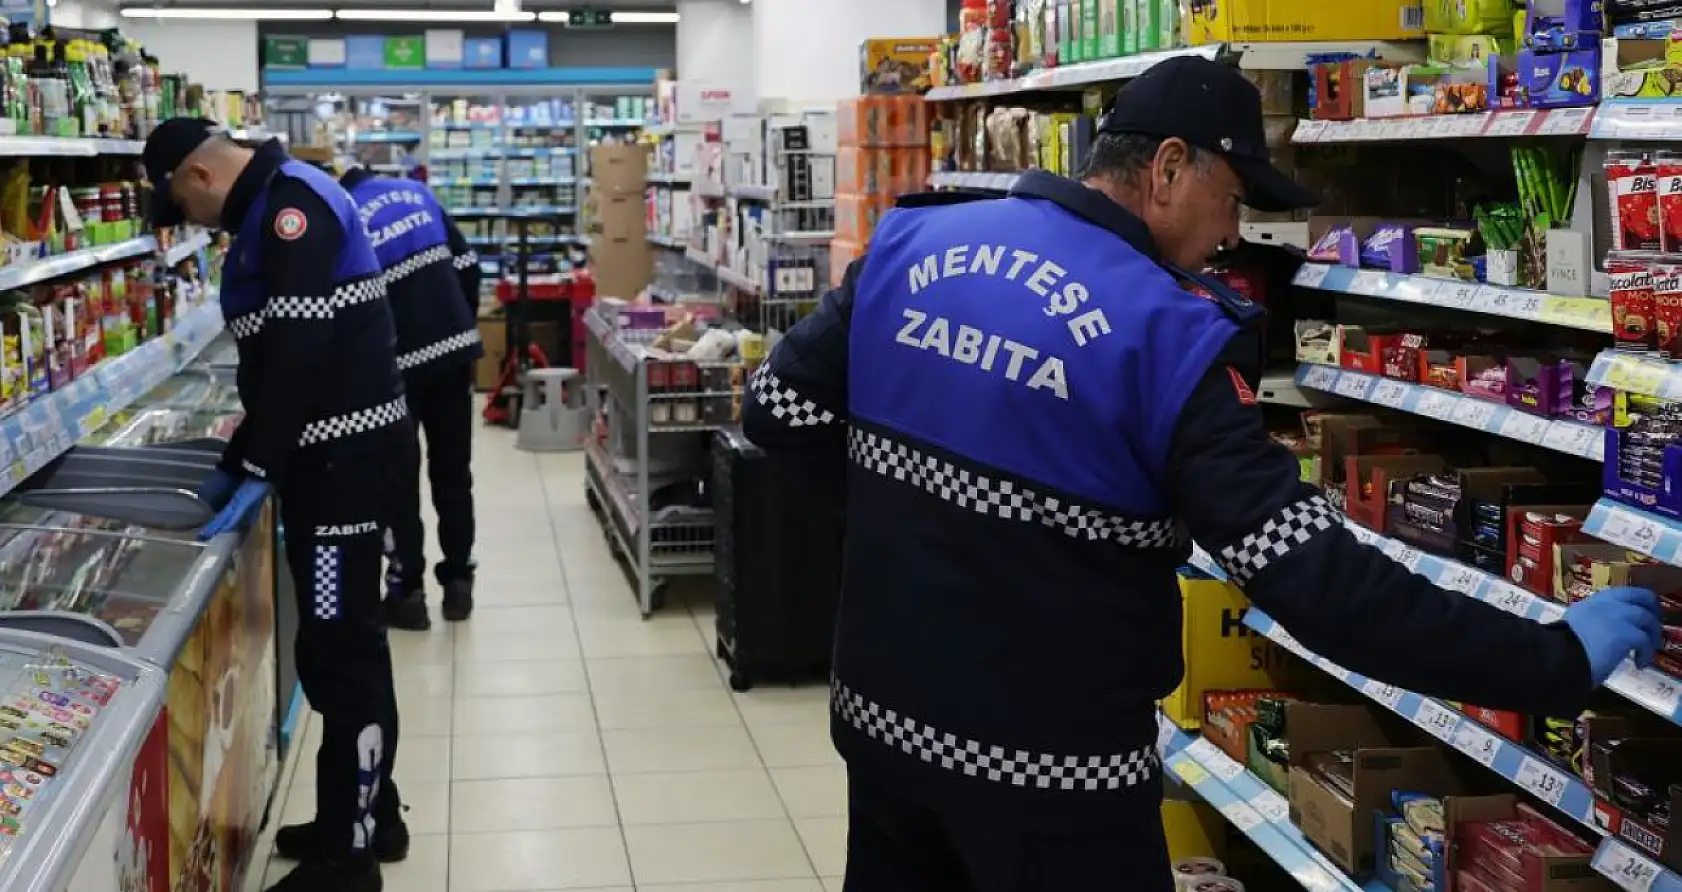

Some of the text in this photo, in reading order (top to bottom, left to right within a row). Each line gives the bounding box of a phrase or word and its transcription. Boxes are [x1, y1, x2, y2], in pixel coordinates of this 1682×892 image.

[908, 244, 1112, 347] MENTEŞE
[896, 308, 1069, 400] ZABITA
[314, 520, 378, 536] ZABITA
